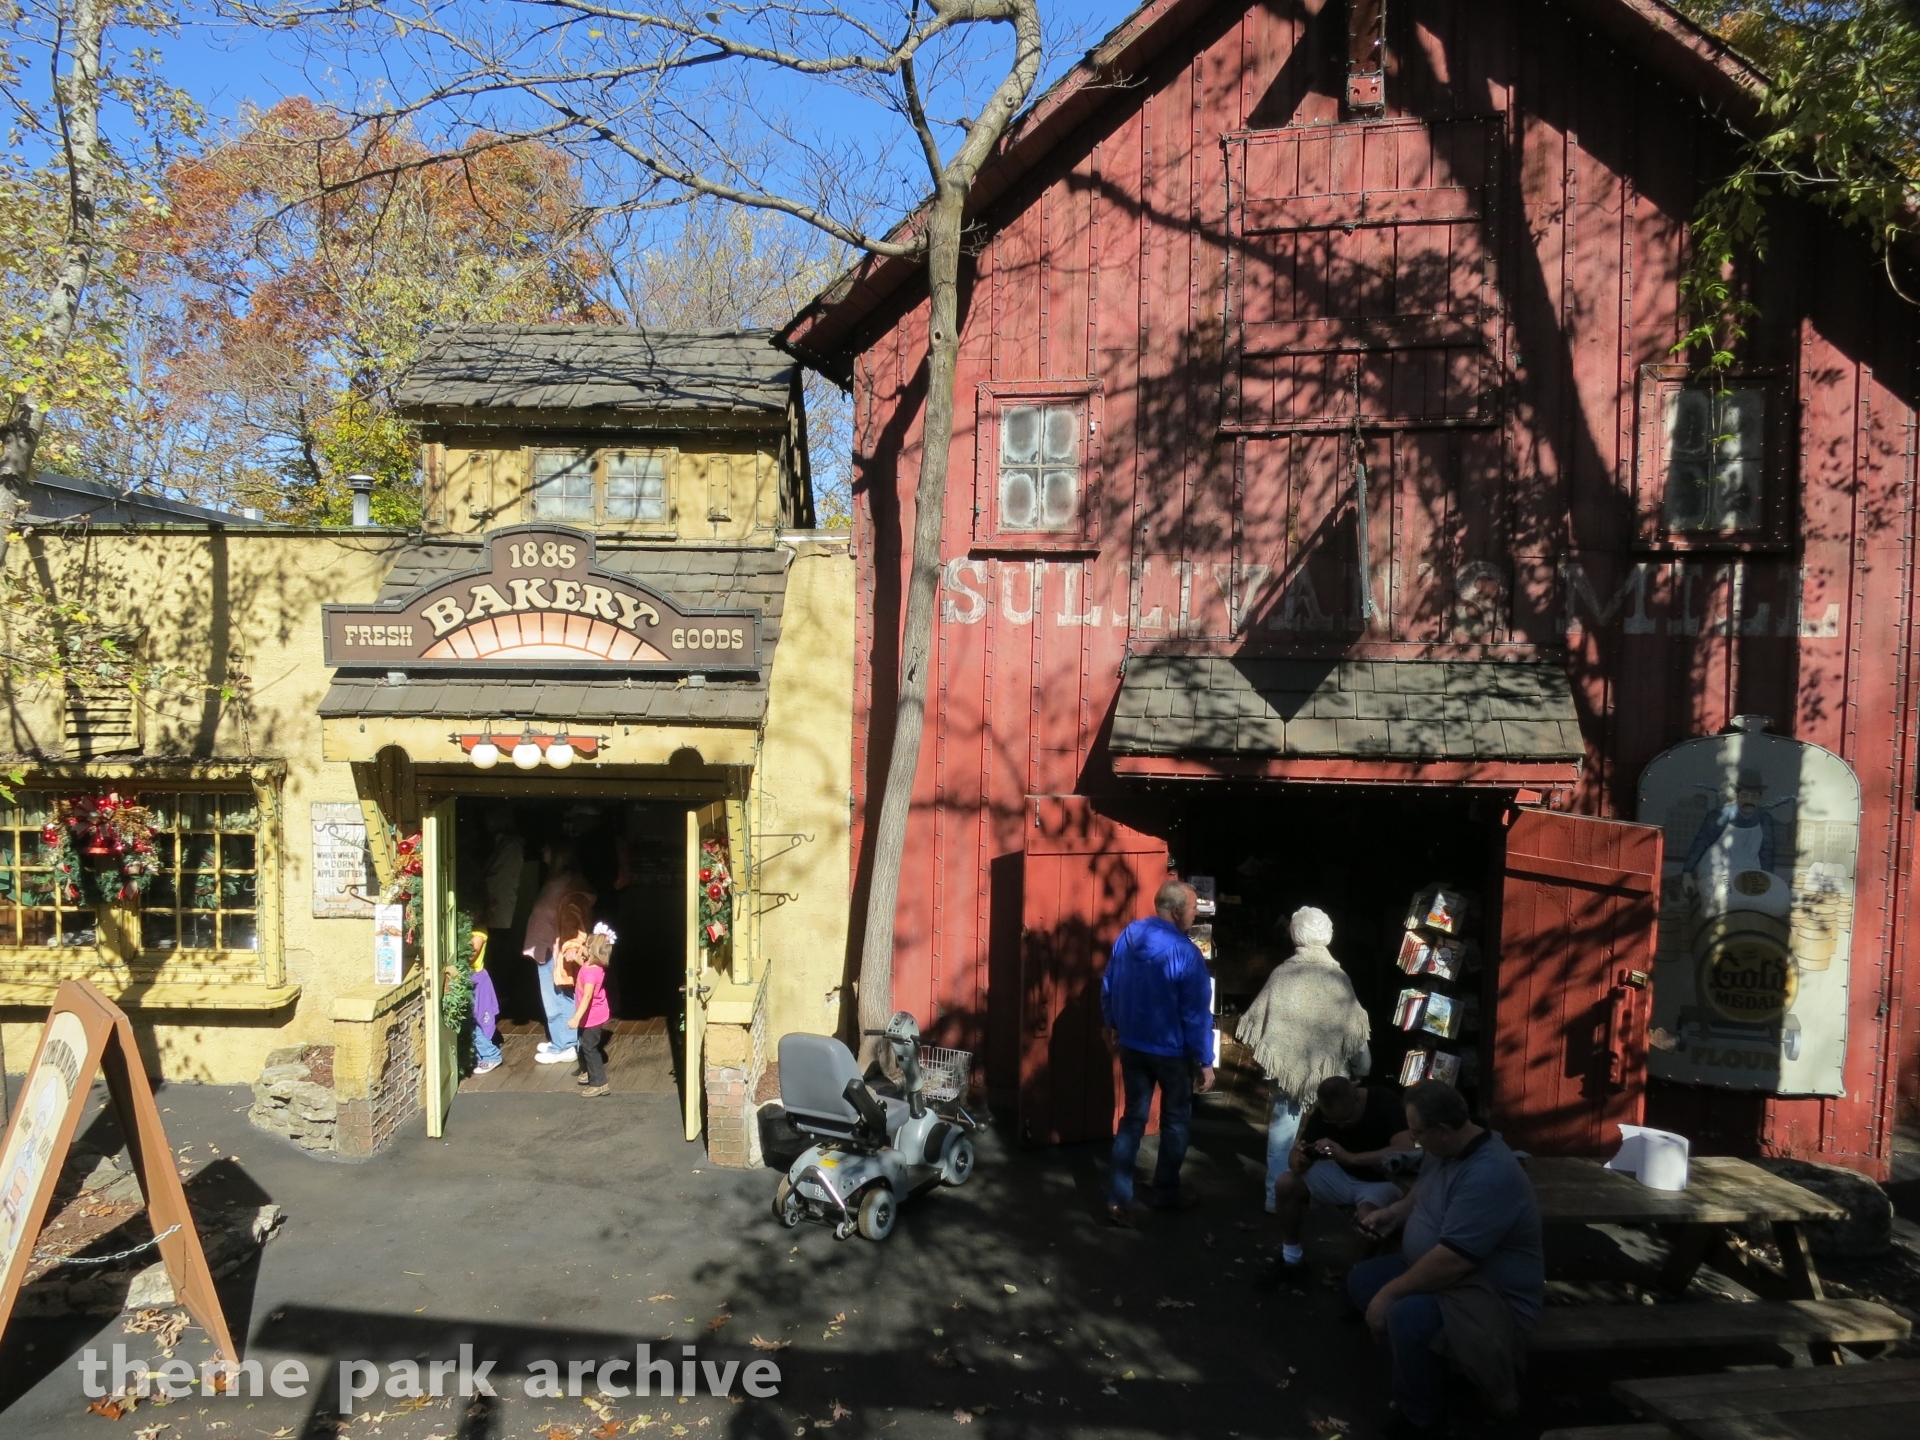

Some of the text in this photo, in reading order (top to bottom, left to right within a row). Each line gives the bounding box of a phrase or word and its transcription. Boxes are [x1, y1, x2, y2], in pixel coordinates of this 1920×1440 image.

[510, 541, 576, 570] 1885
[420, 577, 660, 638] BAKERY
[1555, 561, 1840, 638] MILL
[344, 624, 413, 647] FRESH
[671, 627, 744, 651] GOODS
[331, 860, 354, 869] CORN
[338, 851, 359, 860] WHEAT
[317, 869, 336, 878] APPLE
[338, 869, 363, 878] BUTTER
[1709, 951, 1789, 995] Gold
[1715, 989, 1786, 1010] MEDAL
[1690, 1045, 1782, 1072] FLOUR
